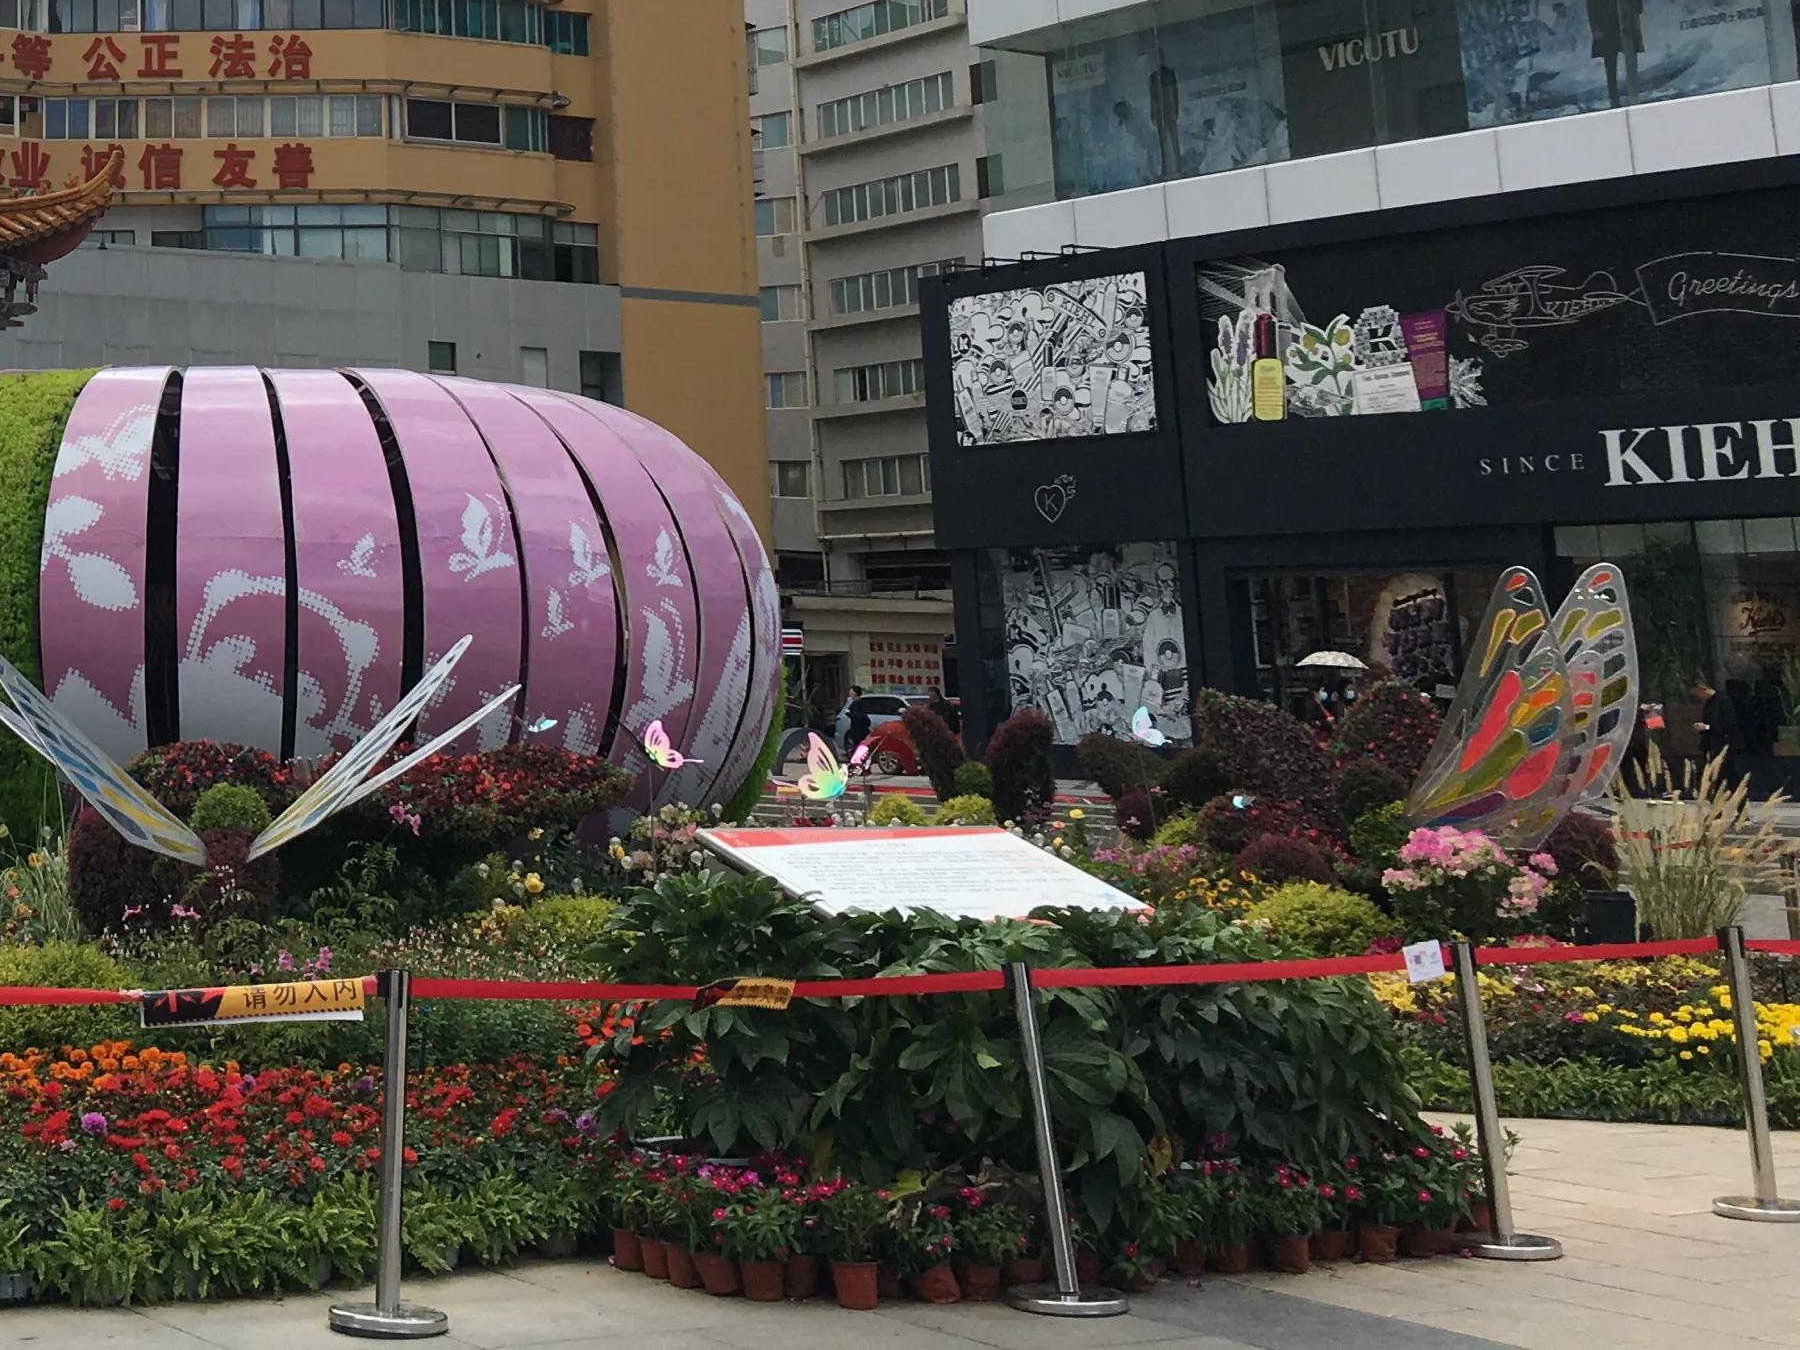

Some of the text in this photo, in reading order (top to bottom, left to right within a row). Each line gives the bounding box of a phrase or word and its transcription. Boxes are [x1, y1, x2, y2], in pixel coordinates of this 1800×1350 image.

[82, 34, 183, 80] 公正
[209, 34, 313, 79] 法治
[1318, 26, 1420, 72] VICUTU
[80, 143, 183, 190] 诚信
[212, 143, 315, 190] 友善
[1668, 269, 1800, 307] Greetings
[1480, 416, 1800, 487] SINCE KIEH
[243, 980, 358, 1011] 请勿入内
